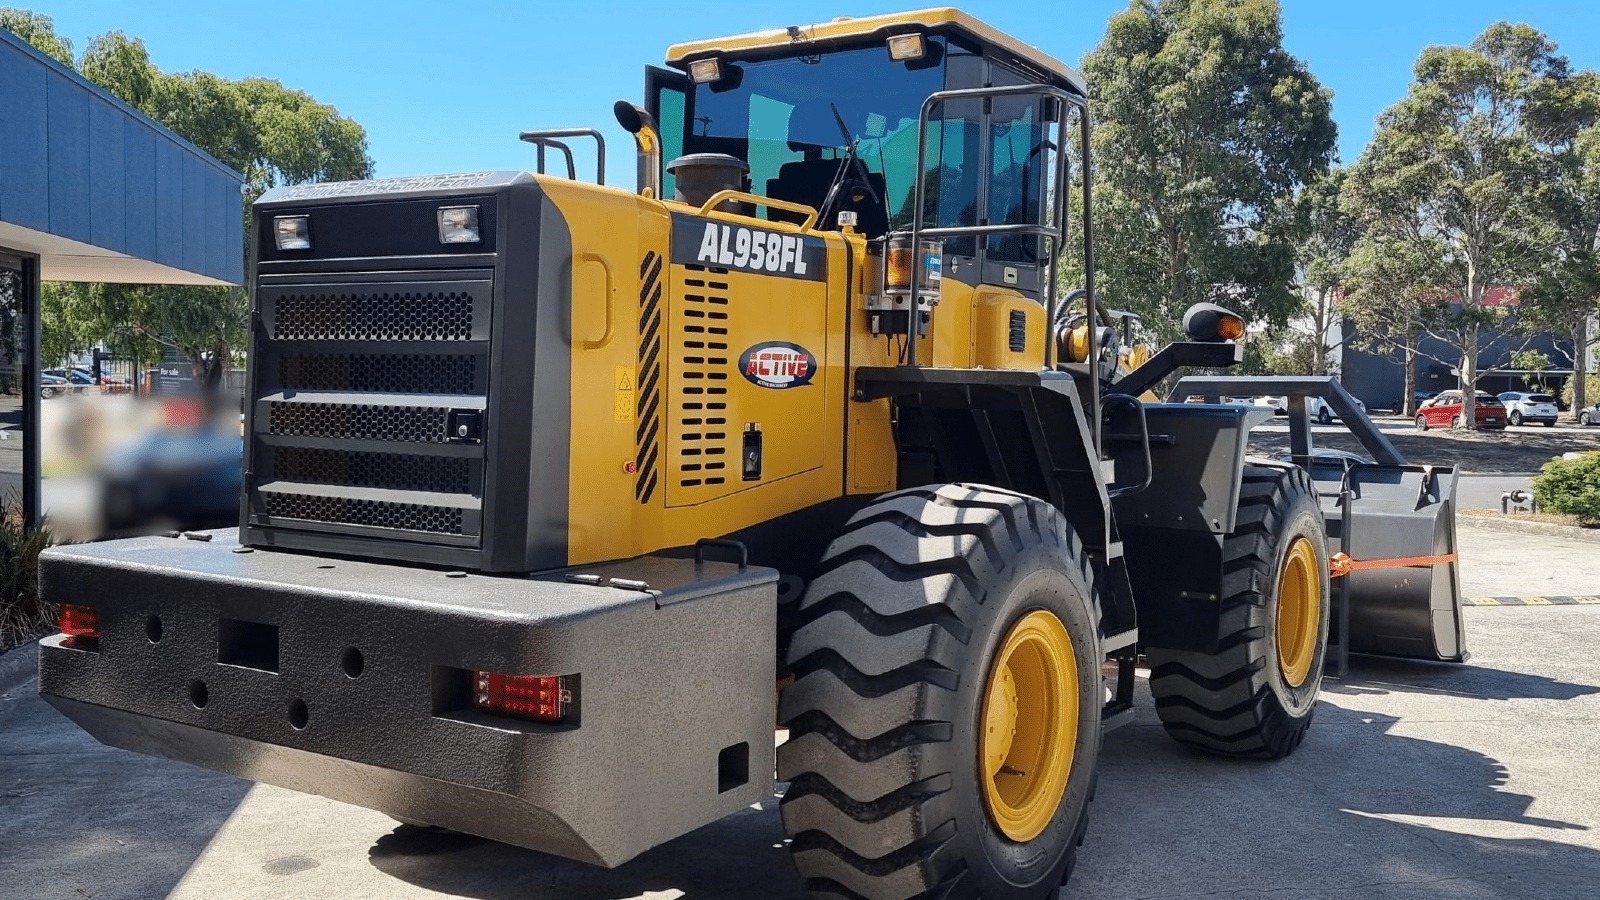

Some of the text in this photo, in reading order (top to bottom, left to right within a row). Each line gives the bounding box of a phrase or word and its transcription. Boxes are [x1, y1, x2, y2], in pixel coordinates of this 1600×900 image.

[697, 222, 807, 275] AL958FL
[169, 368, 178, 376] sale
[746, 352, 808, 377] ACTIVE
